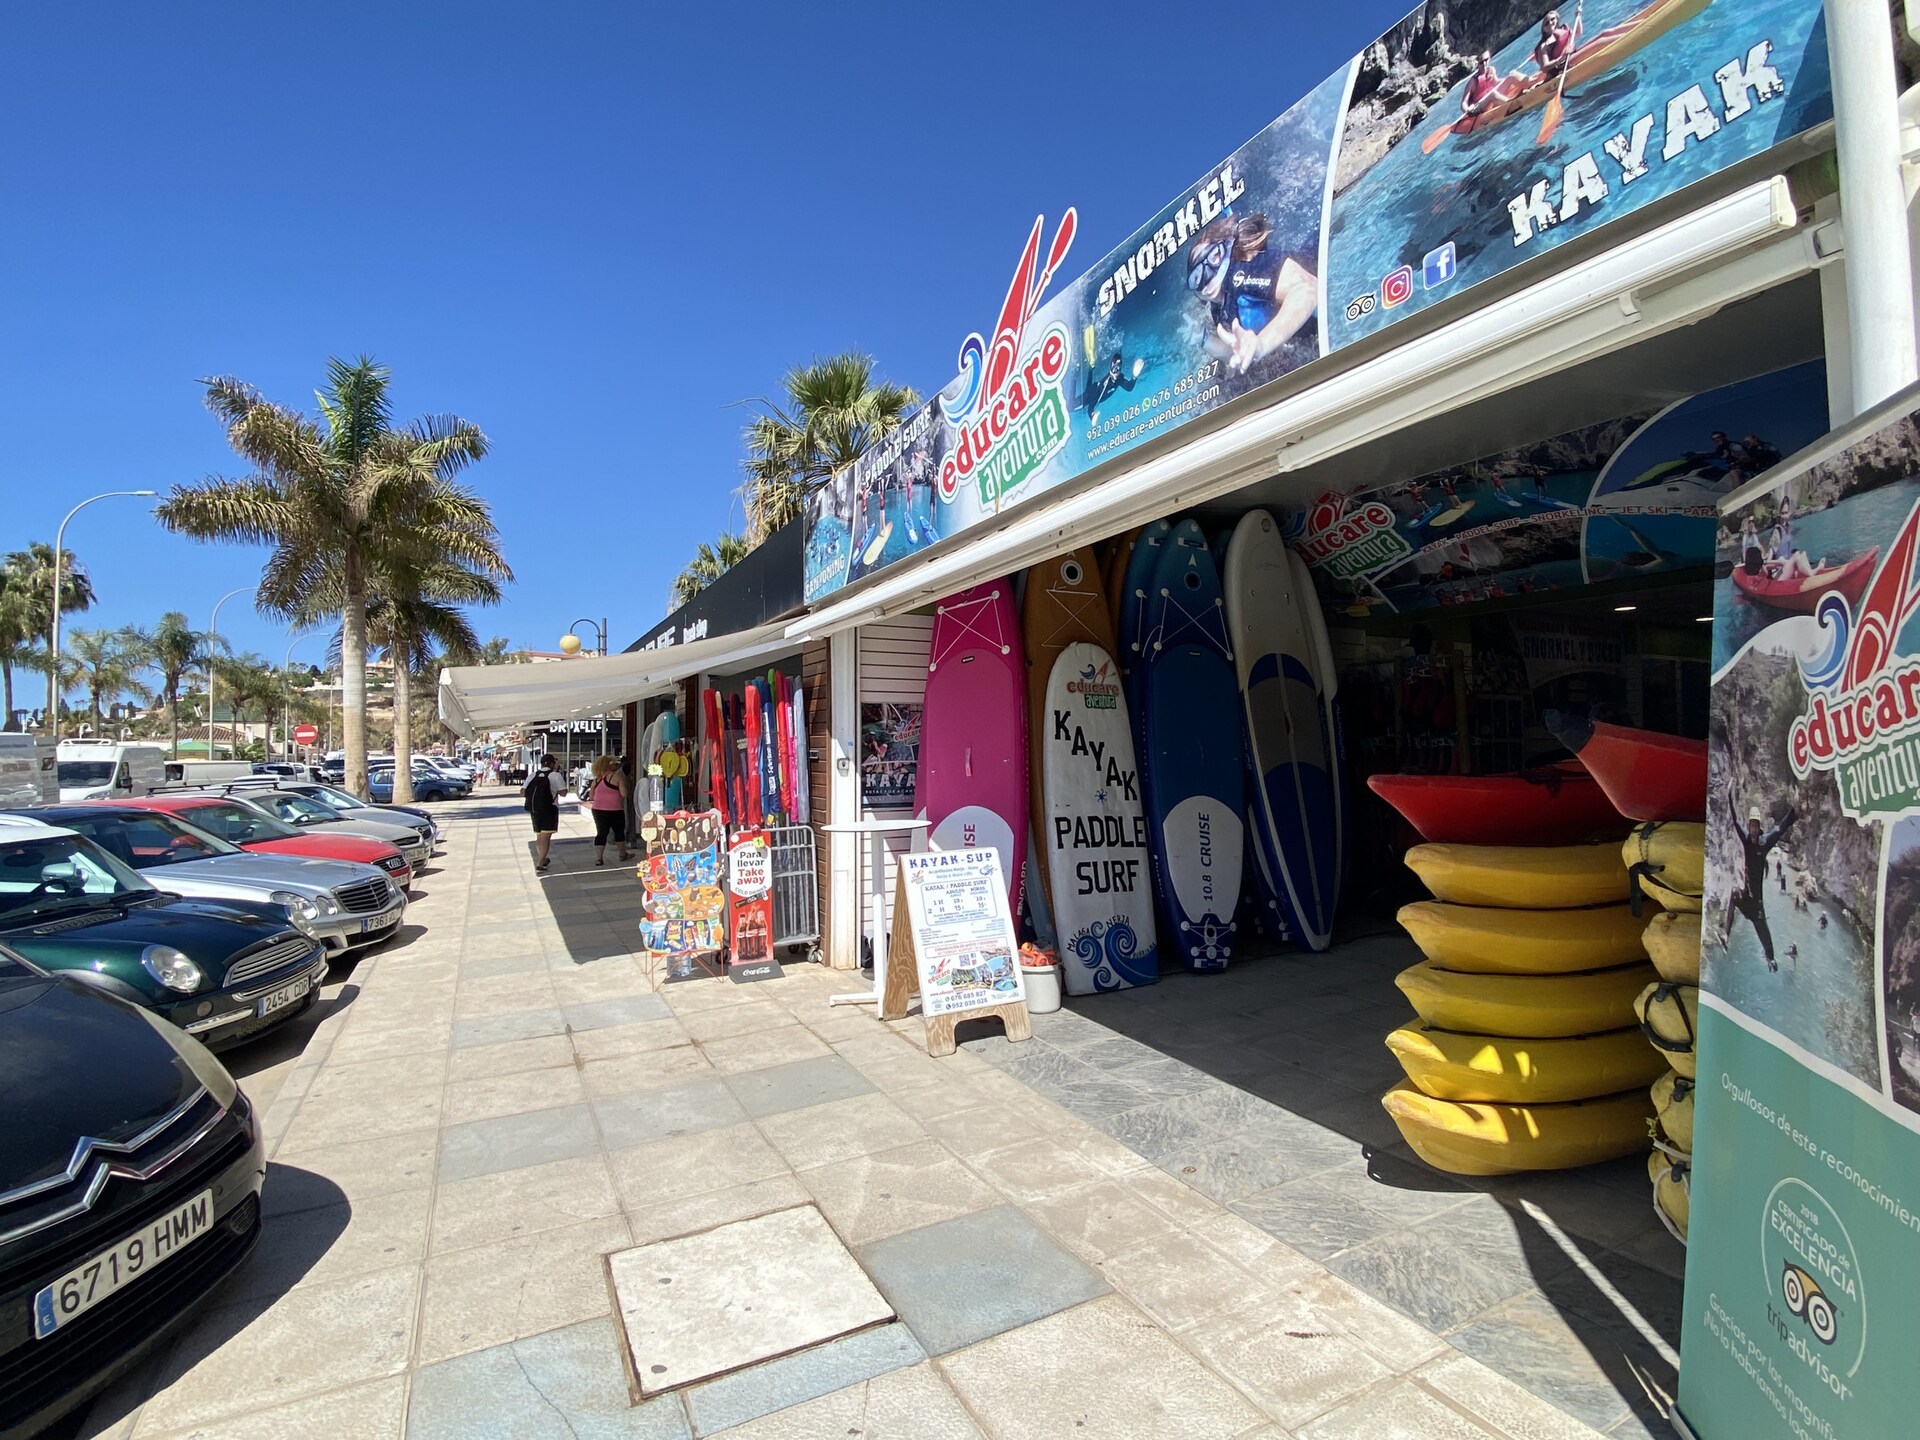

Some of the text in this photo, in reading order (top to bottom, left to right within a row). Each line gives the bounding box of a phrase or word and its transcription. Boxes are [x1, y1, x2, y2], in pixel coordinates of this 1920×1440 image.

[1507, 40, 1784, 247] KAYAK
[1096, 164, 1245, 318] SNORKEL
[942, 335, 1063, 493] educare
[1086, 359, 1219, 443] 952 039 026 676 685 827
[1087, 384, 1220, 461] www.educare-aventura.com
[865, 406, 932, 485] PADDLE SURF
[983, 399, 1059, 500] aventura
[1033, 436, 1059, 464] .com
[1422, 505, 1722, 554] KAYAK PADDEL SURF SNORKELING JET SKI PARA
[1331, 534, 1400, 575] aventura
[1066, 678, 1120, 697] educare
[1086, 694, 1115, 708] aventura
[550, 720, 608, 733] BRUXELLE
[1054, 710, 1138, 801] KAYAK
[740, 851, 762, 859] Para
[1054, 816, 1147, 849] PADDLE
[1198, 812, 1213, 902] 10.8 CRUISE
[737, 859, 765, 868] llevar
[737, 876, 766, 885] away
[738, 867, 764, 877] Take
[1075, 860, 1139, 895] SURF
[265, 979, 308, 1011] 2454 CDR
[1721, 1072, 1776, 1123] Orgullosos
[1777, 1113, 1791, 1135] de
[1792, 1129, 1817, 1157] este
[1778, 1199, 1850, 1271] CERTIFICADO de
[1800, 1203, 1819, 1226] 2018
[60, 1197, 208, 1314] 6719 HMM
[1771, 1209, 1857, 1302] EXCELENCIA
[43, 1315, 52, 1327] E
[1709, 1292, 1746, 1345] Gracias
[1747, 1340, 1767, 1366] por
[1768, 1357, 1783, 1388] las
[1720, 1327, 1730, 1349] lo
[1767, 1301, 1848, 1401] tripadvisor
